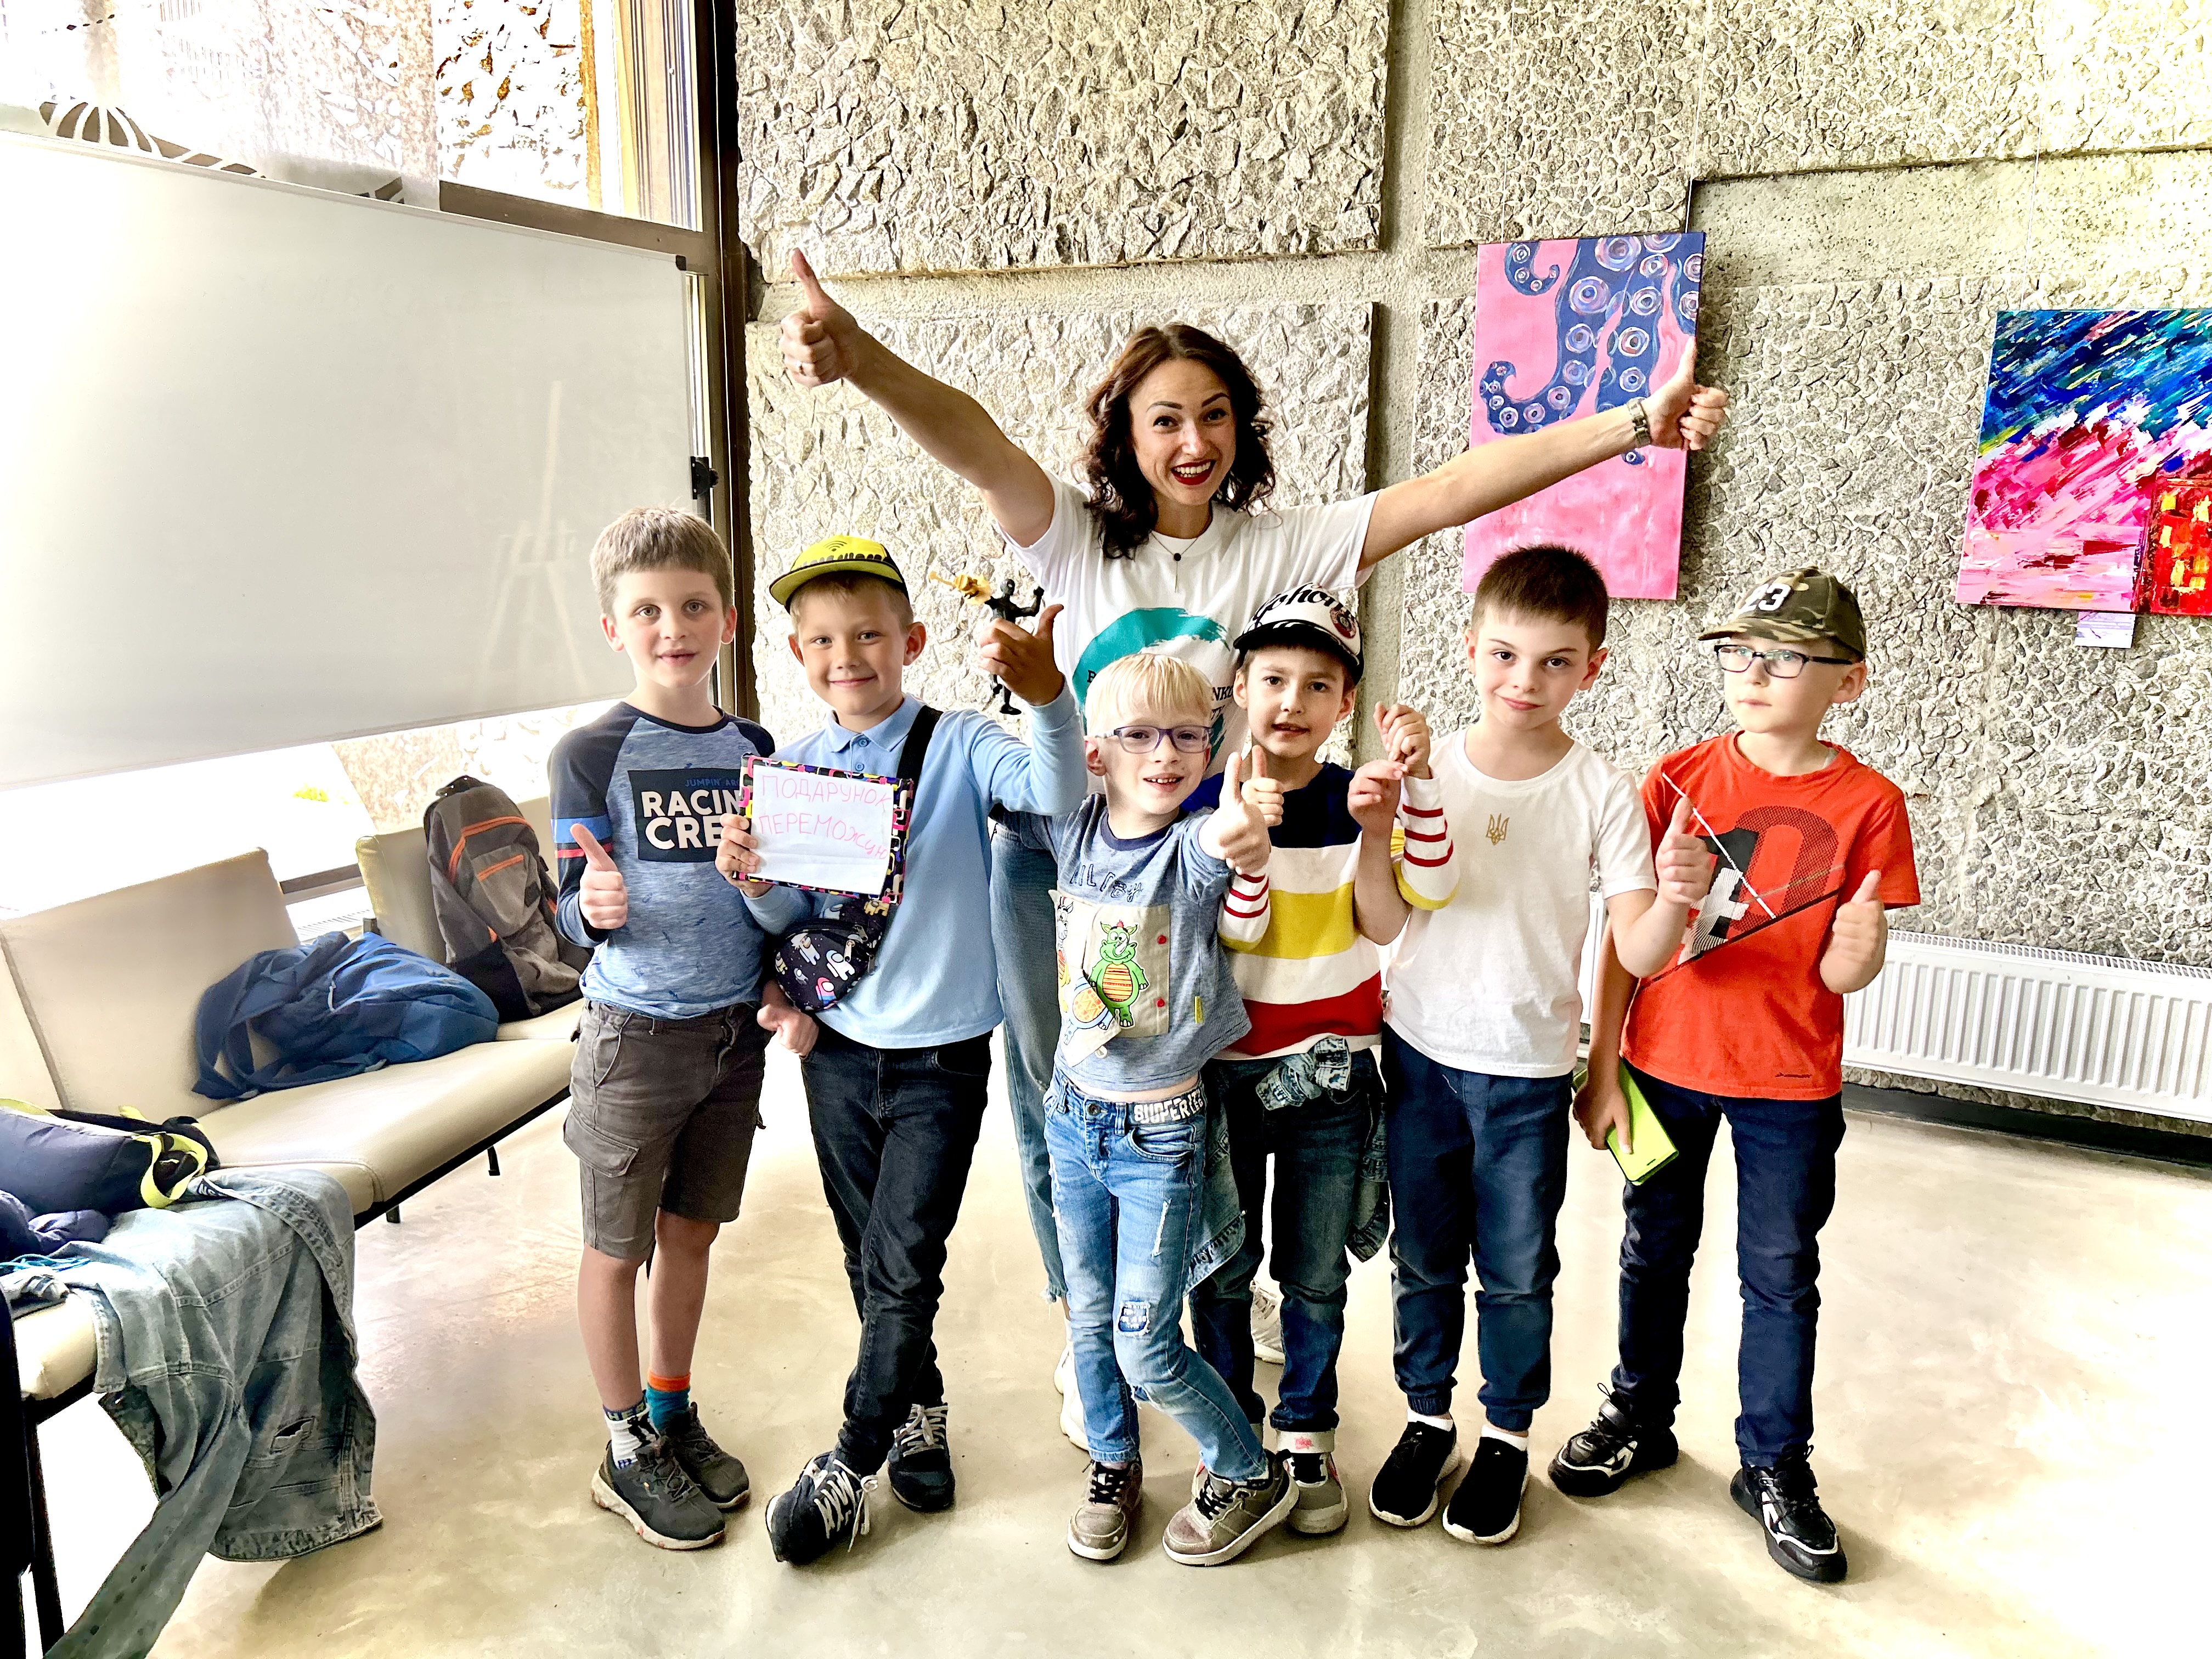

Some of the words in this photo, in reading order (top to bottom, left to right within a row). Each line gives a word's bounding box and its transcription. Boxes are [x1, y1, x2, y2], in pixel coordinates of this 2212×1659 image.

[641, 789, 740, 818] RACIN
[763, 775, 891, 812] ПОДАРУНОК
[645, 815, 721, 850] CRE
